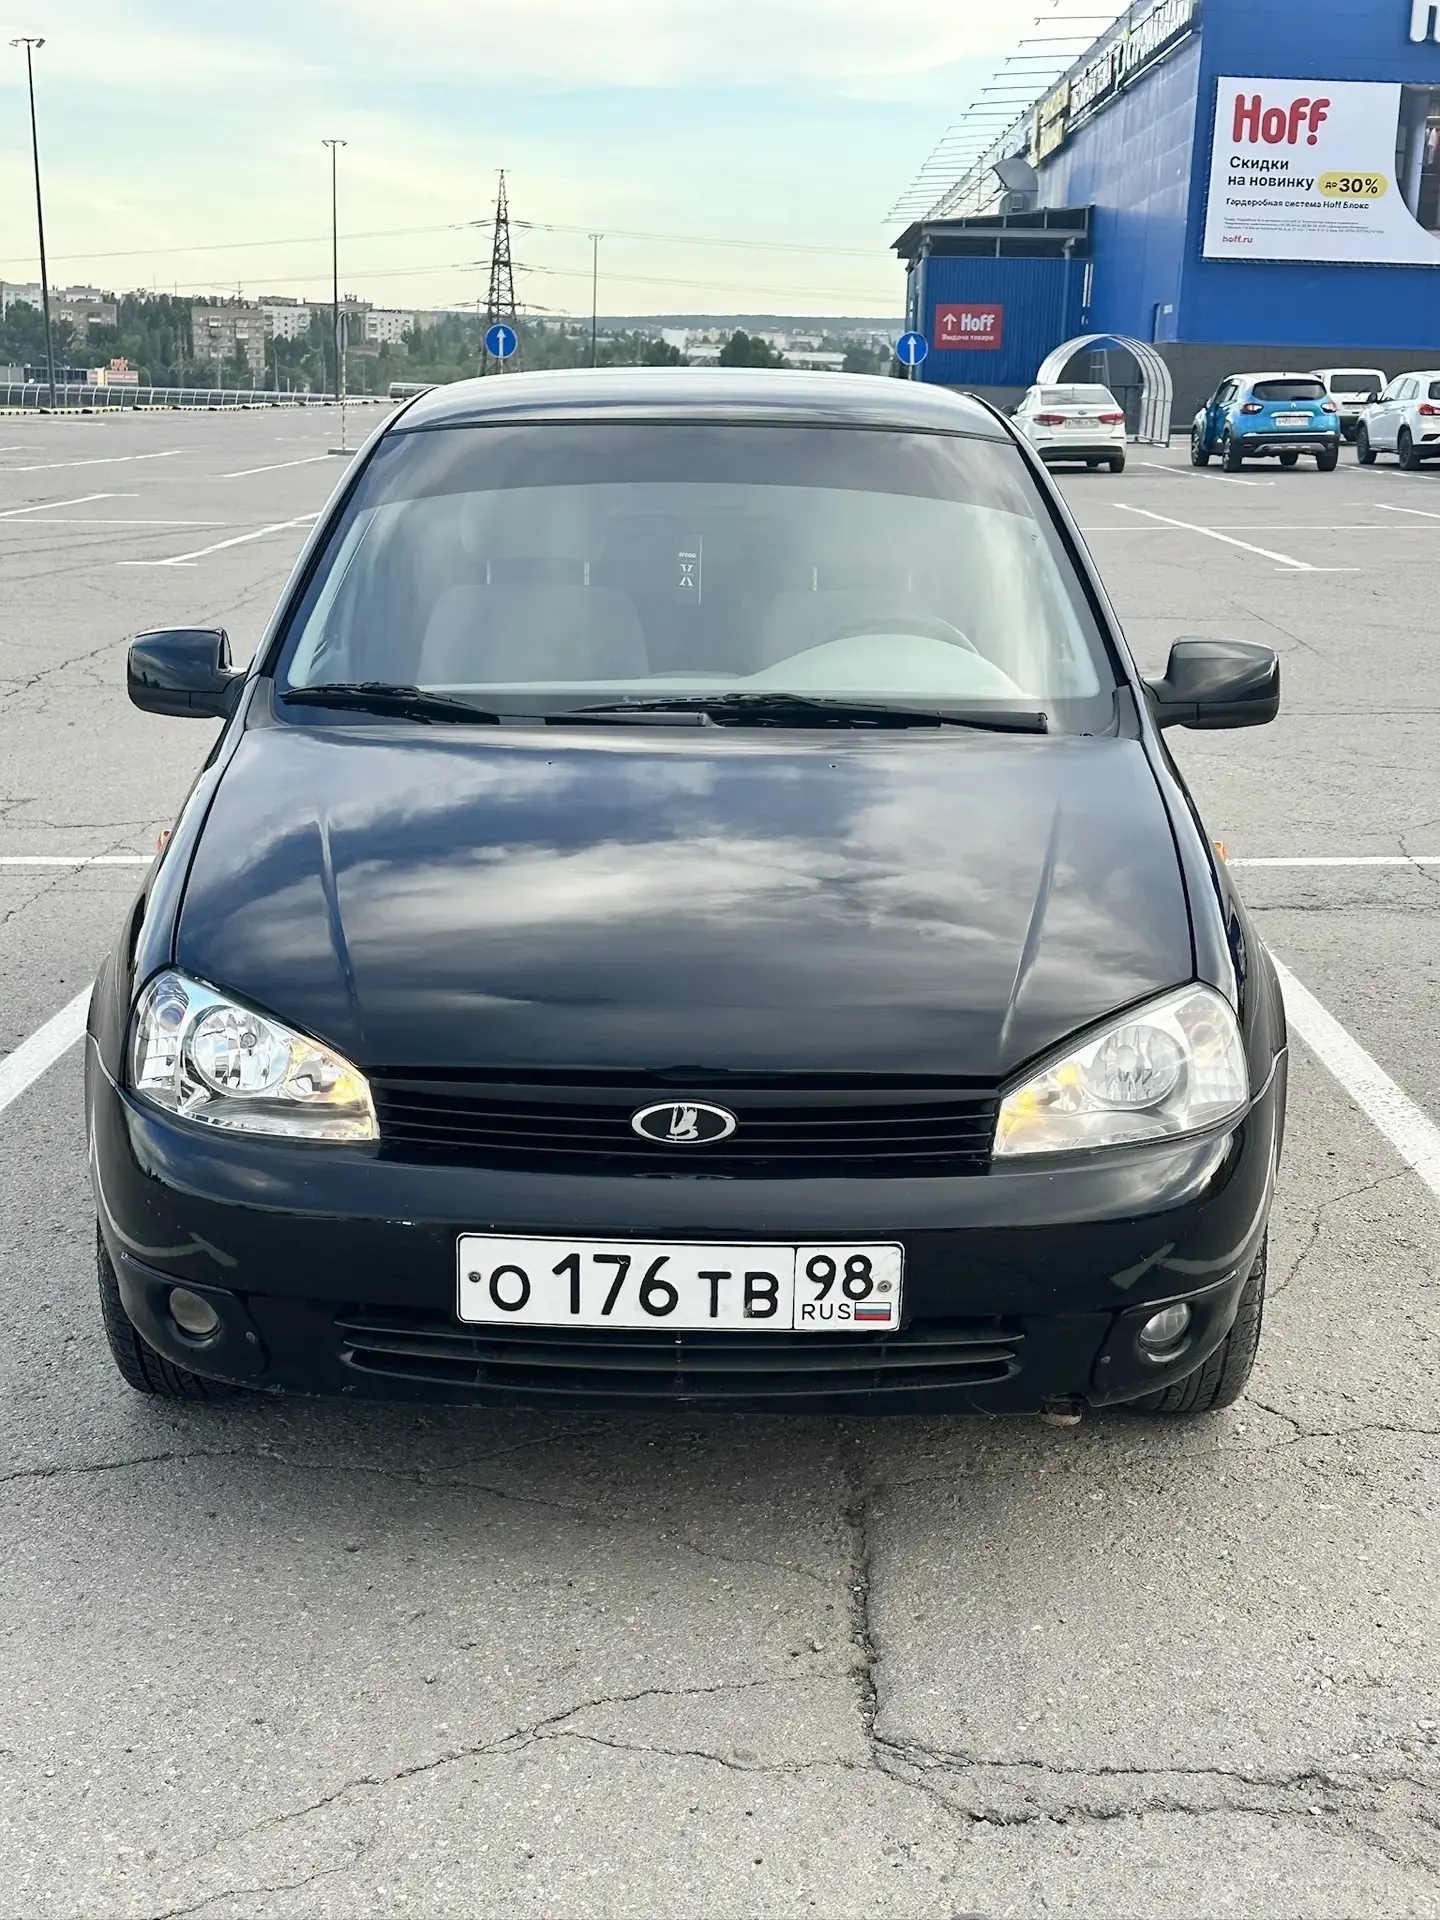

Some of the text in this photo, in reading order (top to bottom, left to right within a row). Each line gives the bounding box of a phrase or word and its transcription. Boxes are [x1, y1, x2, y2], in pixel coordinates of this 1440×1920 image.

[1232, 94, 1331, 146] Hoff
[1229, 156, 1289, 172] Скидки
[1228, 175, 1315, 191] на новинку
[1325, 178, 1378, 194] до 30%
[1226, 198, 1284, 207] Гардеробная
[1284, 200, 1322, 208] система
[1222, 235, 1253, 243] hoff.ru
[961, 313, 995, 331] Hoff
[805, 1254, 874, 1301] 98
[801, 1302, 852, 1321] RUS
